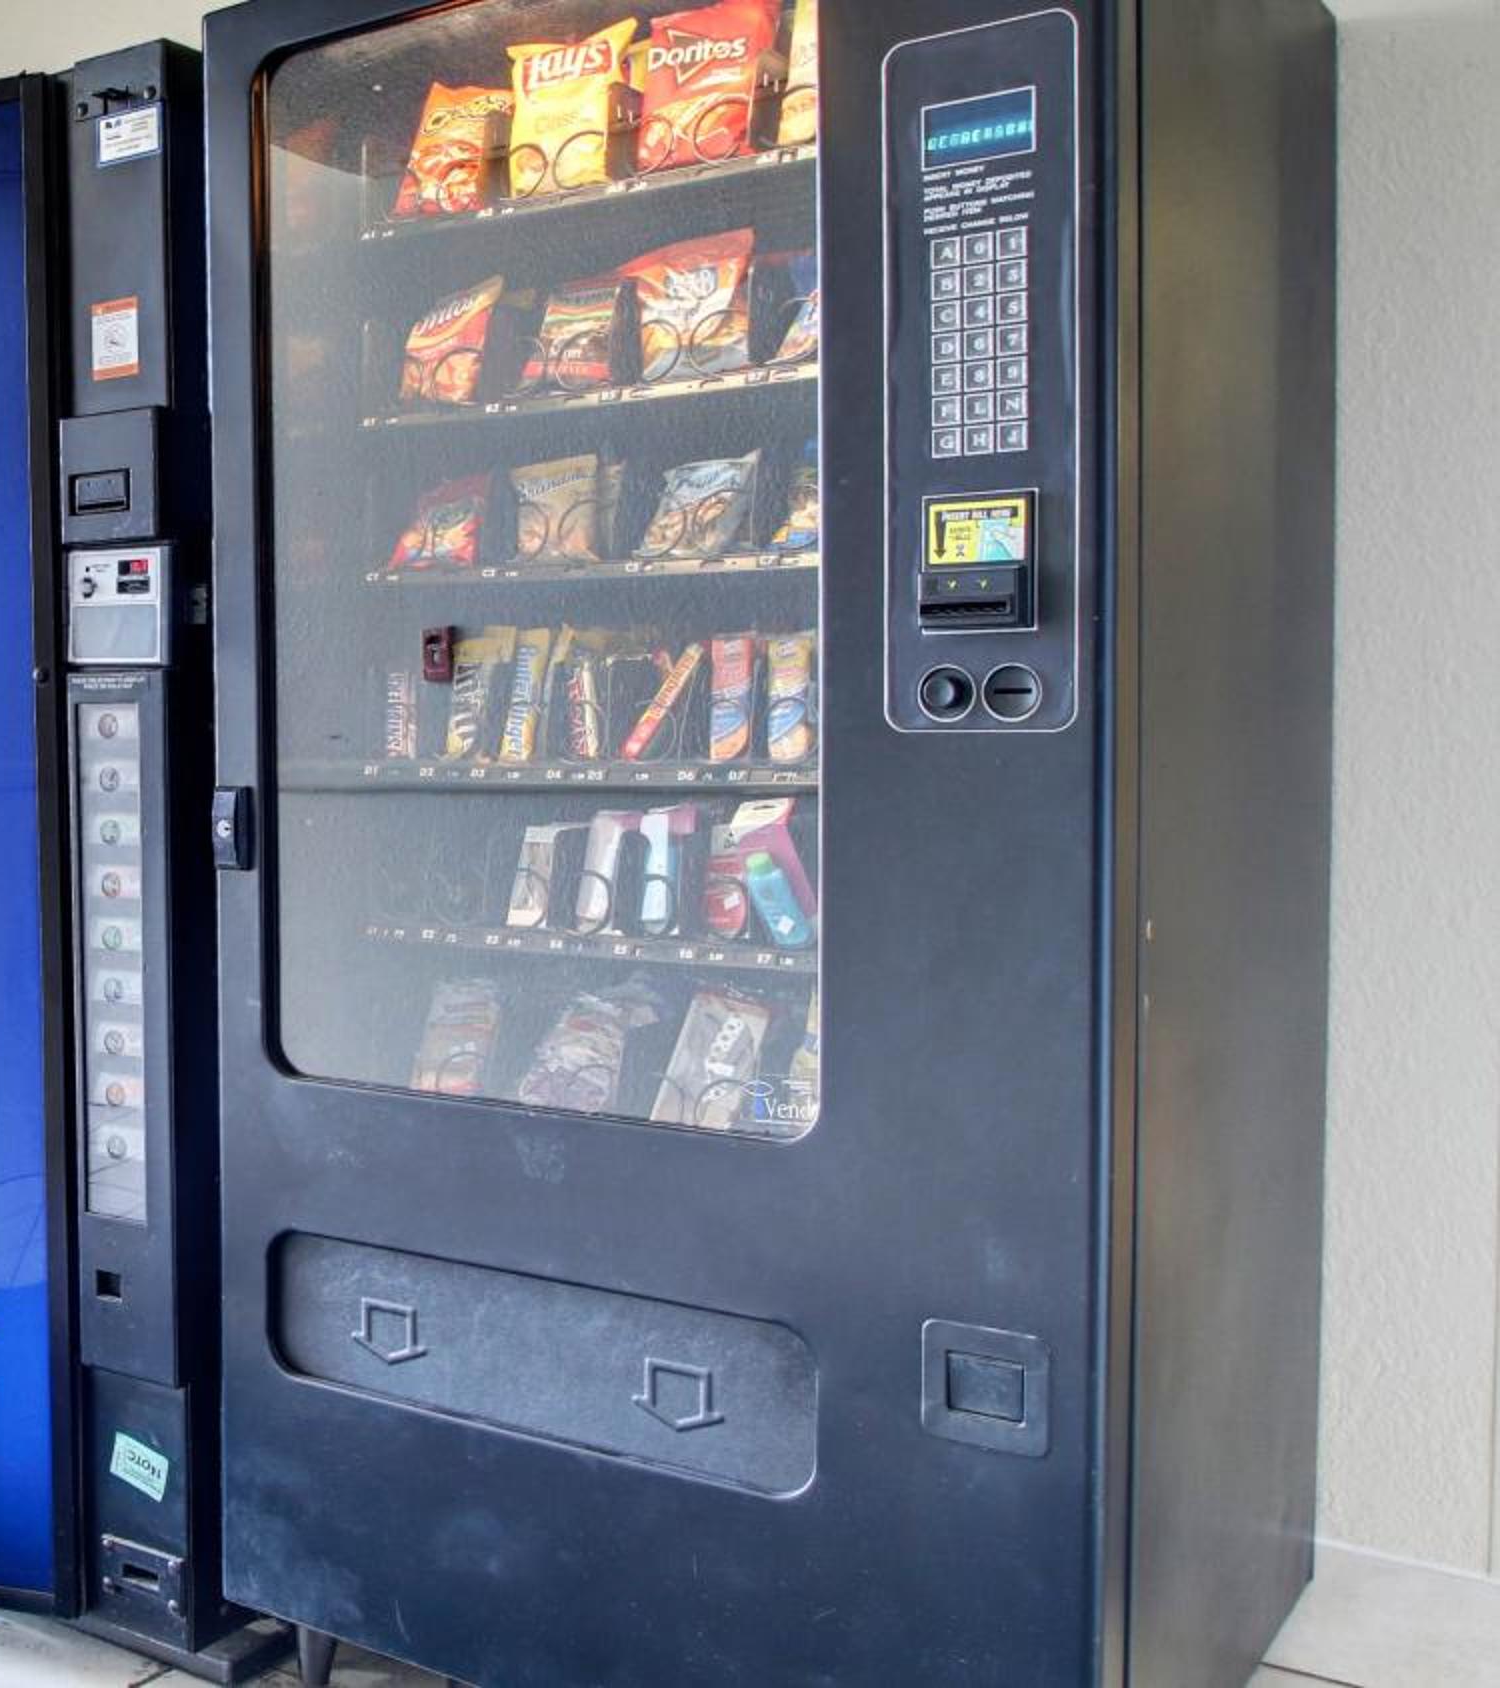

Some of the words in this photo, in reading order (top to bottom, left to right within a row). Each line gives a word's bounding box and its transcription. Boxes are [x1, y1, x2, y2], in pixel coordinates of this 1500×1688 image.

[647, 36, 748, 71] Doritos
[955, 165, 984, 177] MONEY
[940, 247, 953, 259] A
[1009, 238, 1016, 250] 1
[941, 278, 953, 290] B
[973, 274, 984, 287] 2
[1008, 269, 1018, 282] 3
[940, 309, 953, 322] C
[974, 305, 985, 319] 4
[1008, 301, 1019, 315] 5
[941, 341, 954, 355] D
[973, 337, 985, 350] 6
[1007, 333, 1018, 346] 7
[941, 373, 954, 386] E
[974, 369, 985, 383] 8
[974, 401, 986, 414] L
[1005, 397, 1019, 410] N
[940, 435, 954, 449] G
[972, 433, 986, 447] H
